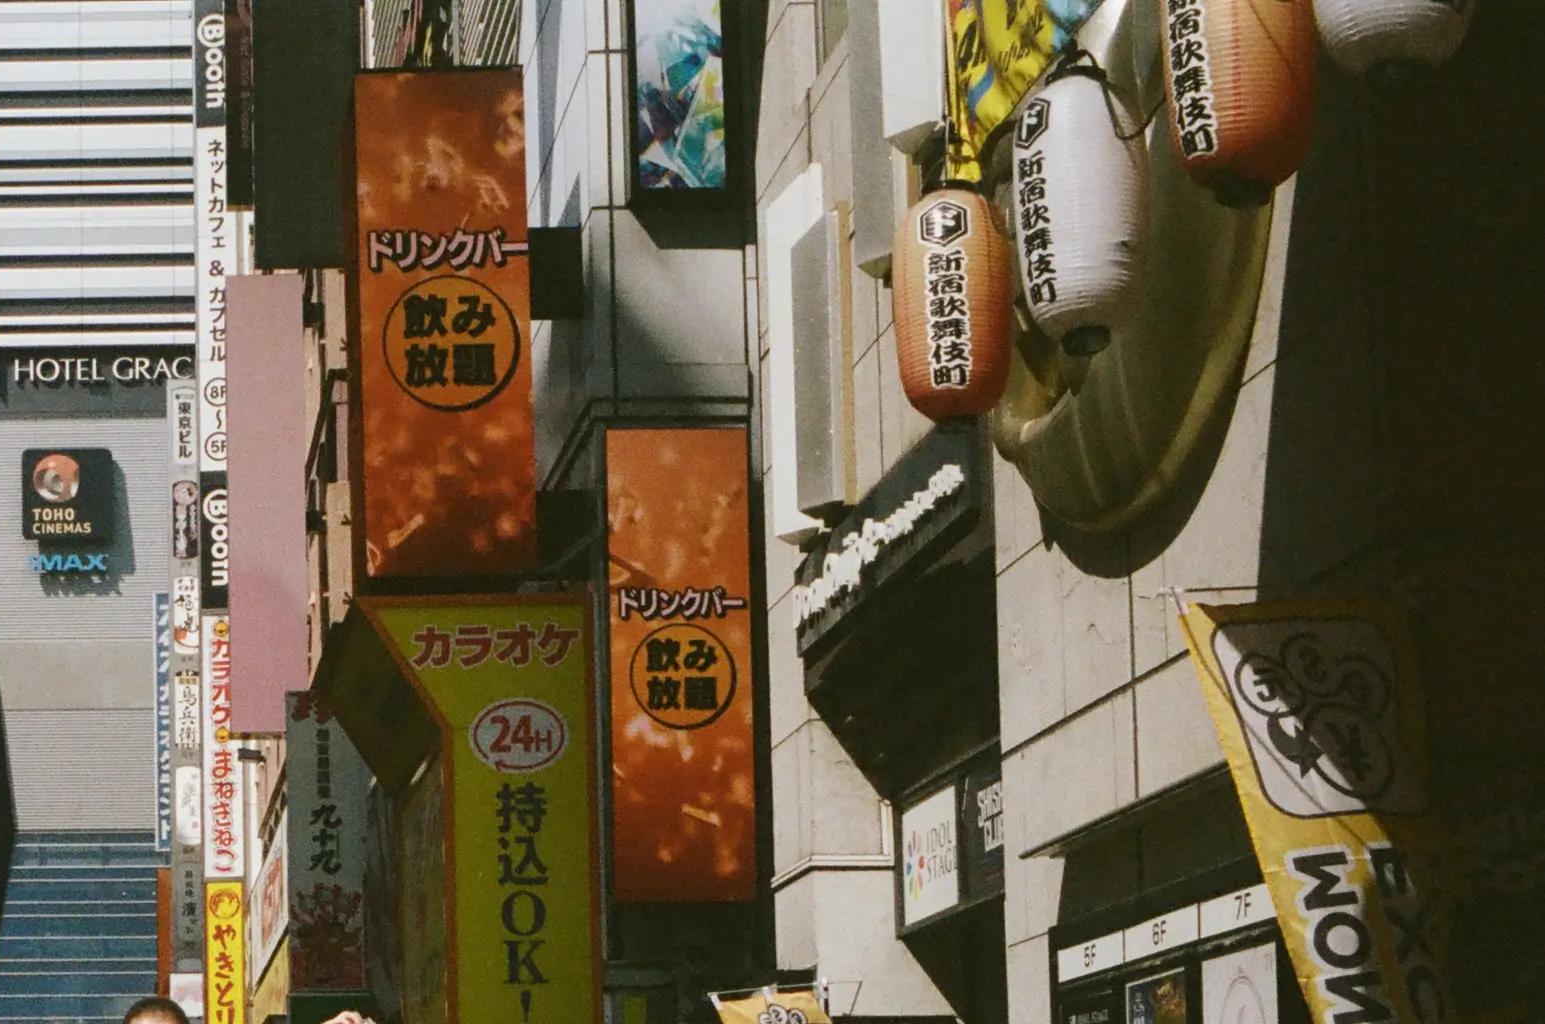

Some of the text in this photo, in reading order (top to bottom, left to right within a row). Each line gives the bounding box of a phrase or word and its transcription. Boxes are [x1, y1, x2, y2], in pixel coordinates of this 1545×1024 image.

[197, 13, 225, 108] Booth
[208, 139, 226, 249] ネットカフェ
[366, 228, 529, 273] ドリンクバー
[1018, 150, 1058, 306] 新宿歌舞伎町
[403, 293, 497, 340] 飲み
[928, 251, 971, 387] 新宿歌舞伎町
[13, 356, 193, 382] HOTEL GRAC
[178, 402, 193, 459] 東京ビル
[32, 507, 76, 522] TOHO
[32, 522, 92, 534] CINEMAS
[618, 587, 747, 624] ドリンクバー
[412, 622, 580, 670] カラオケ
[645, 637, 718, 674] 飲み
[211, 638, 231, 726] カラオケ
[489, 714, 554, 755] 24H
[212, 748, 235, 873] まねきねこ
[309, 803, 343, 876] 九十九
[926, 820, 953, 855] IDOL
[1234, 892, 1253, 921] 7F
[1152, 920, 1167, 946] 6F
